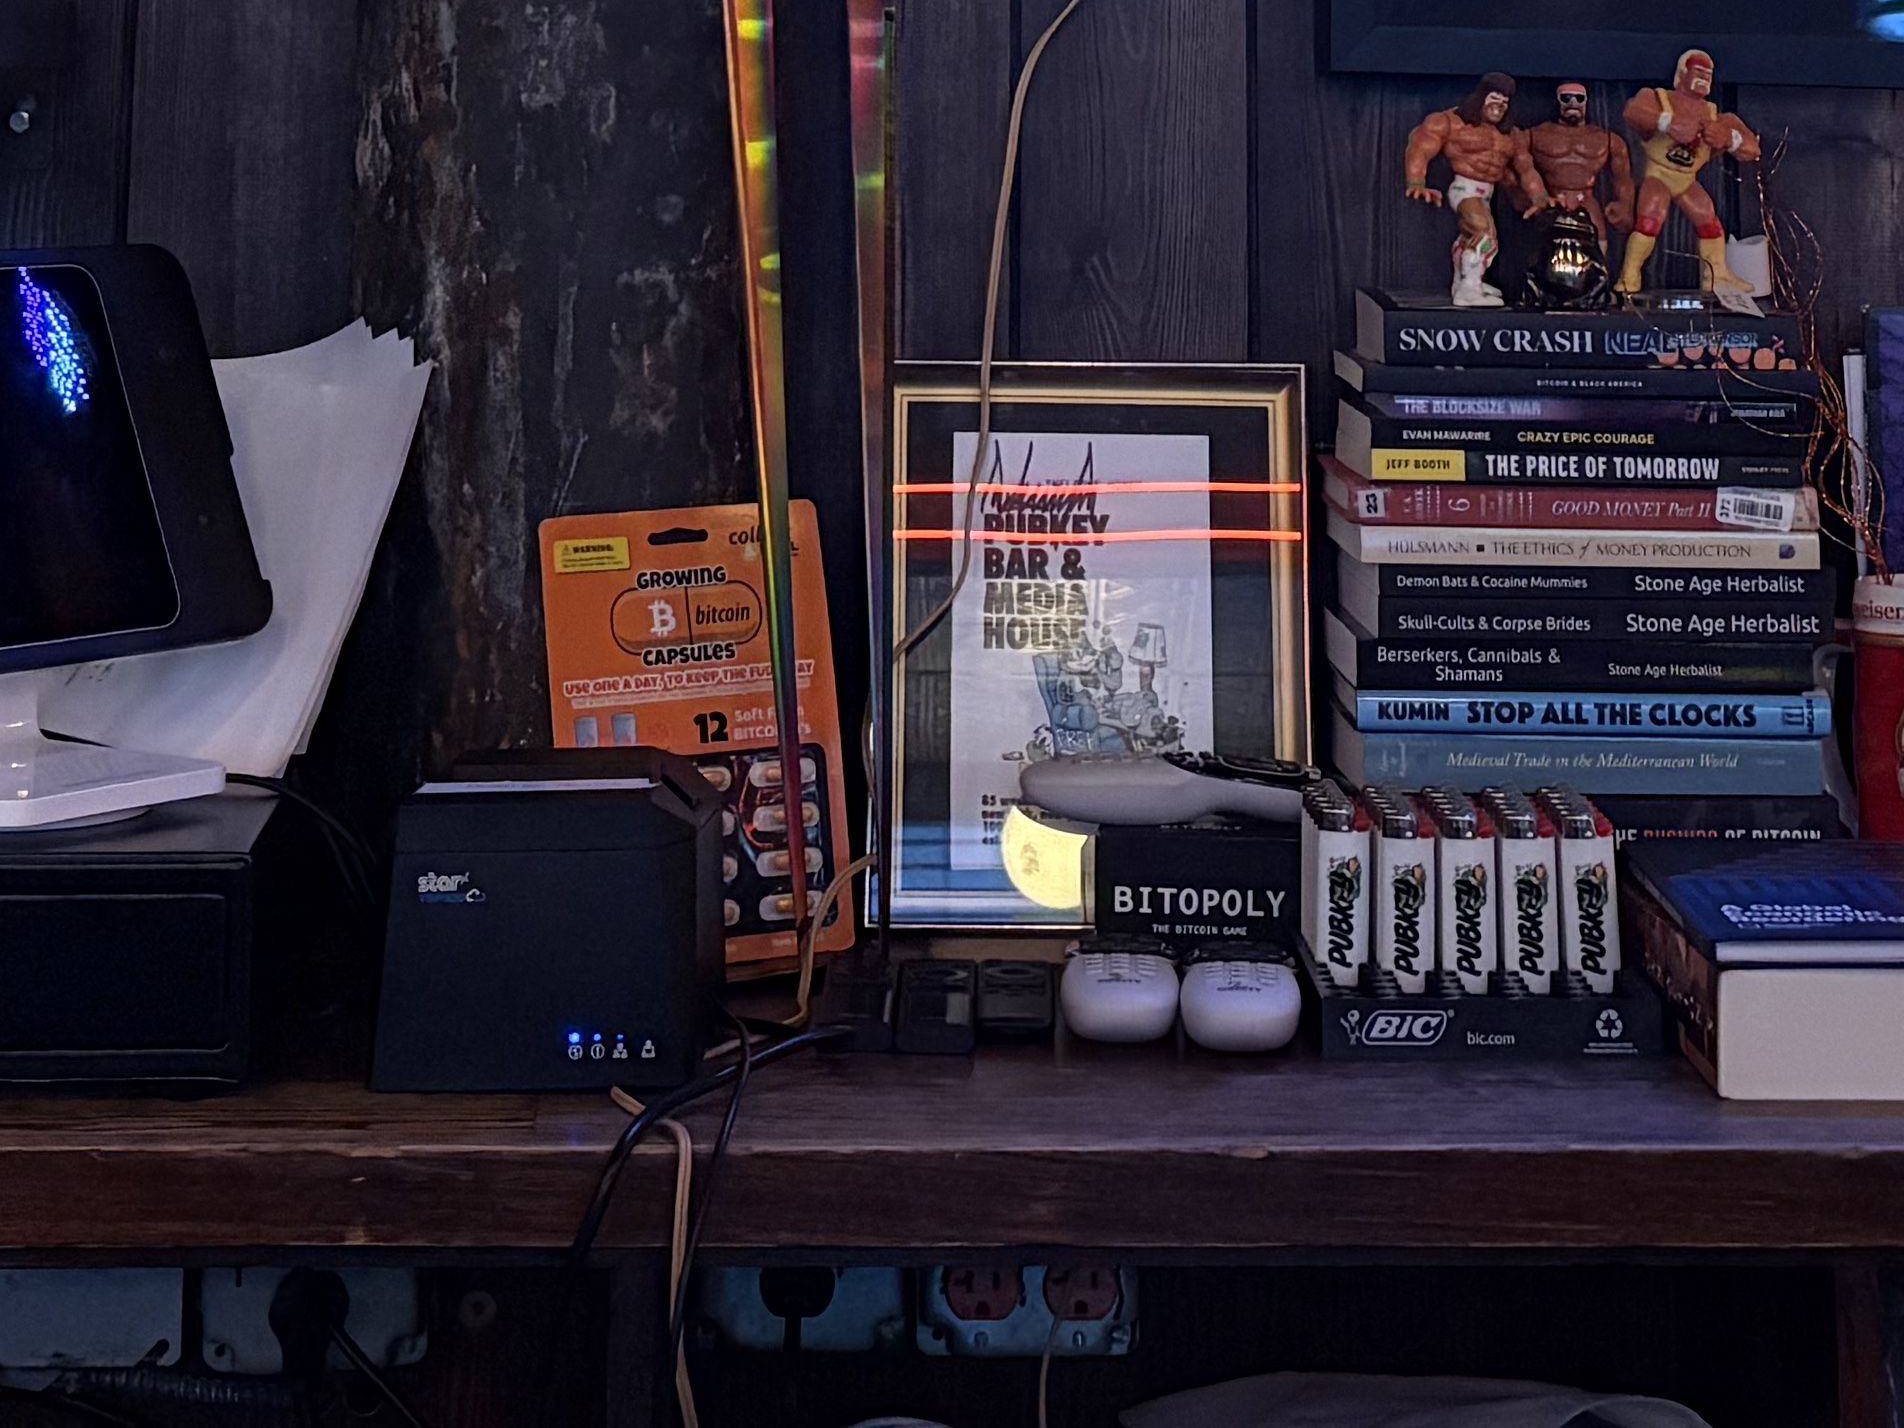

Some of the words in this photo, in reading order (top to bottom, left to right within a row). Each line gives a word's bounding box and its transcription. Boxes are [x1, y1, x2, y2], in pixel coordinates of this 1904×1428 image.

[1399, 328, 1486, 352] SNOW
[1493, 328, 1593, 354] CRASH
[1404, 399, 1428, 414] THE
[1431, 399, 1505, 415] BLOCKSIZE
[1510, 400, 1542, 415] WAR
[1402, 430, 1431, 441] EVAN
[1517, 432, 1560, 443] CRAZY
[1563, 433, 1591, 444] EPIC
[1594, 433, 1655, 445] COURAGE
[1386, 459, 1411, 470] JEFF
[1413, 459, 1450, 470] BOOTH
[1485, 454, 1521, 478] THE
[1525, 455, 1582, 479] PRICE
[1584, 456, 1607, 479] OF
[1612, 456, 1721, 481] TOMORROW
[1551, 501, 1599, 517] GOOD
[1603, 501, 1663, 518] MONEY
[1666, 503, 1695, 518] Part
[1491, 540, 1520, 556] THE
[1523, 541, 1575, 556] ETHICS
[1595, 542, 1648, 558] MONEY
[1651, 542, 1752, 559] PRODUCTION
[984, 547, 1049, 580] BAR
[1061, 548, 1086, 580] &
[1397, 576, 1440, 588] Demon
[1441, 576, 1468, 588] Bats
[1481, 576, 1528, 588] Cocaine
[1530, 576, 1588, 589] Mummies
[1634, 575, 1684, 593] Stone
[1688, 576, 1724, 595] Age
[1727, 576, 1806, 594] Herbalist
[695, 604, 751, 625] bitcoin
[1398, 615, 1475, 632] Skull-Cults
[1478, 616, 1489, 631] &
[1492, 616, 1543, 635] Corpse
[1546, 616, 1591, 632] Brides
[1625, 613, 1683, 634] Stone
[1686, 614, 1726, 637] Age
[1731, 614, 1820, 634] Herbalist
[1376, 646, 1463, 665] Berserkers,
[1467, 647, 1542, 664] Cannibals
[1548, 648, 1561, 664] &
[1607, 663, 1642, 676] Stone
[1644, 663, 1667, 679] Age
[1669, 663, 1723, 677] Herbalist
[1435, 665, 1504, 682] Shamans
[1377, 700, 1450, 722] KUMIN
[1466, 700, 1535, 725] STOP
[1541, 701, 1589, 726] ALL
[1594, 702, 1642, 727] THE
[1648, 702, 1757, 729] CLOCKS
[693, 711, 729, 744] 12
[734, 708, 763, 722] Soft
[1446, 752, 1511, 768] Medieval
[1513, 752, 1551, 768] Trade
[1572, 753, 1593, 768] the
[1595, 753, 1694, 769] Mediterranean
[1698, 753, 1739, 769] World
[1114, 885, 1286, 918] BITOPOLY
[1152, 923, 1169, 934] THE
[1176, 924, 1218, 935] BITCOIN
[1222, 926, 1247, 936] GAME
[1370, 1015, 1443, 1038] BIC
[1467, 1031, 1515, 1045] bic.com
